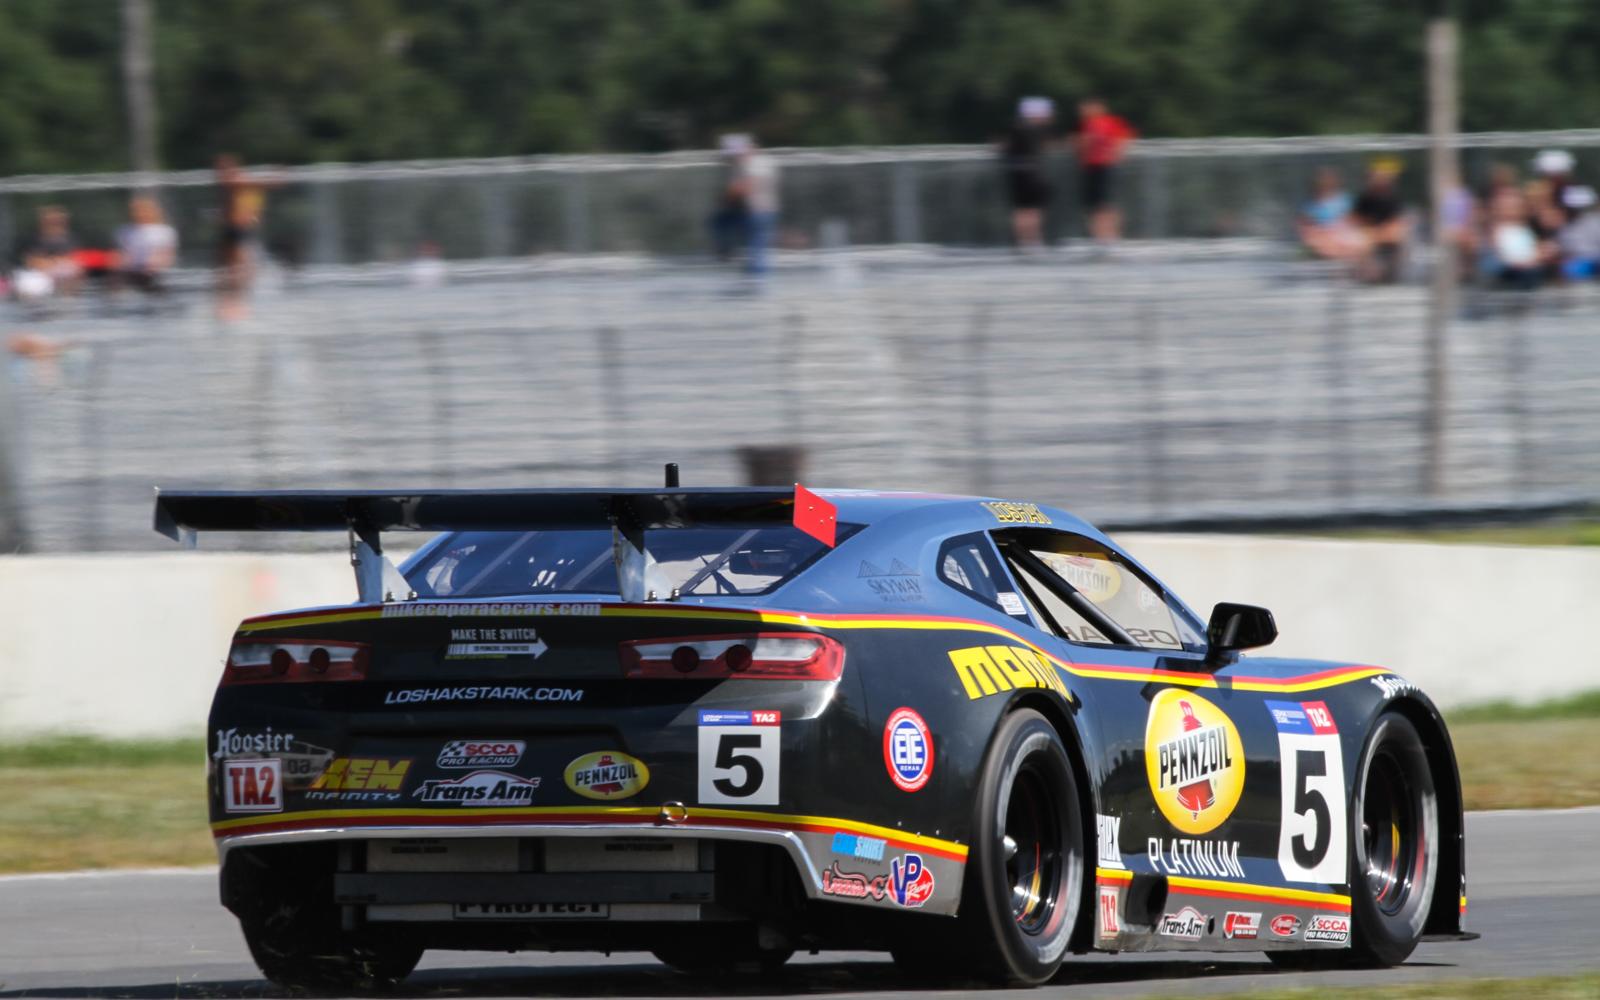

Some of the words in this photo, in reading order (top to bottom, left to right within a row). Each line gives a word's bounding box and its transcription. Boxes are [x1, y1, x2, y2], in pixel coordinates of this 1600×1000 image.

[866, 579, 922, 595] SKYWAY
[451, 629, 477, 641] MAKE
[479, 629, 497, 641] THE
[499, 628, 537, 641] SWITCH
[385, 687, 584, 705] LOSHAKSTARK.COM
[754, 713, 777, 723] TA2
[1306, 708, 1331, 727] TA2
[213, 727, 294, 758] Hoosier
[465, 743, 519, 756] SCCA
[440, 756, 469, 766] PRO
[469, 755, 516, 766] RACING
[712, 734, 764, 798] 5
[1159, 726, 1232, 788] PENNZOIL
[574, 763, 638, 787] PENNZOIL
[229, 766, 276, 806] TA2
[304, 791, 401, 801] INFINITY
[424, 781, 488, 801] Trans
[488, 779, 534, 800] Am
[1291, 749, 1332, 870] 5
[1148, 837, 1245, 878] PLATINUM
[890, 853, 922, 905] VP
[1101, 895, 1120, 932] TA2
[1162, 916, 1185, 934] Trans
[1186, 917, 1202, 936] Am
[1317, 919, 1347, 931] SCCA
[1316, 931, 1346, 941] RACING
